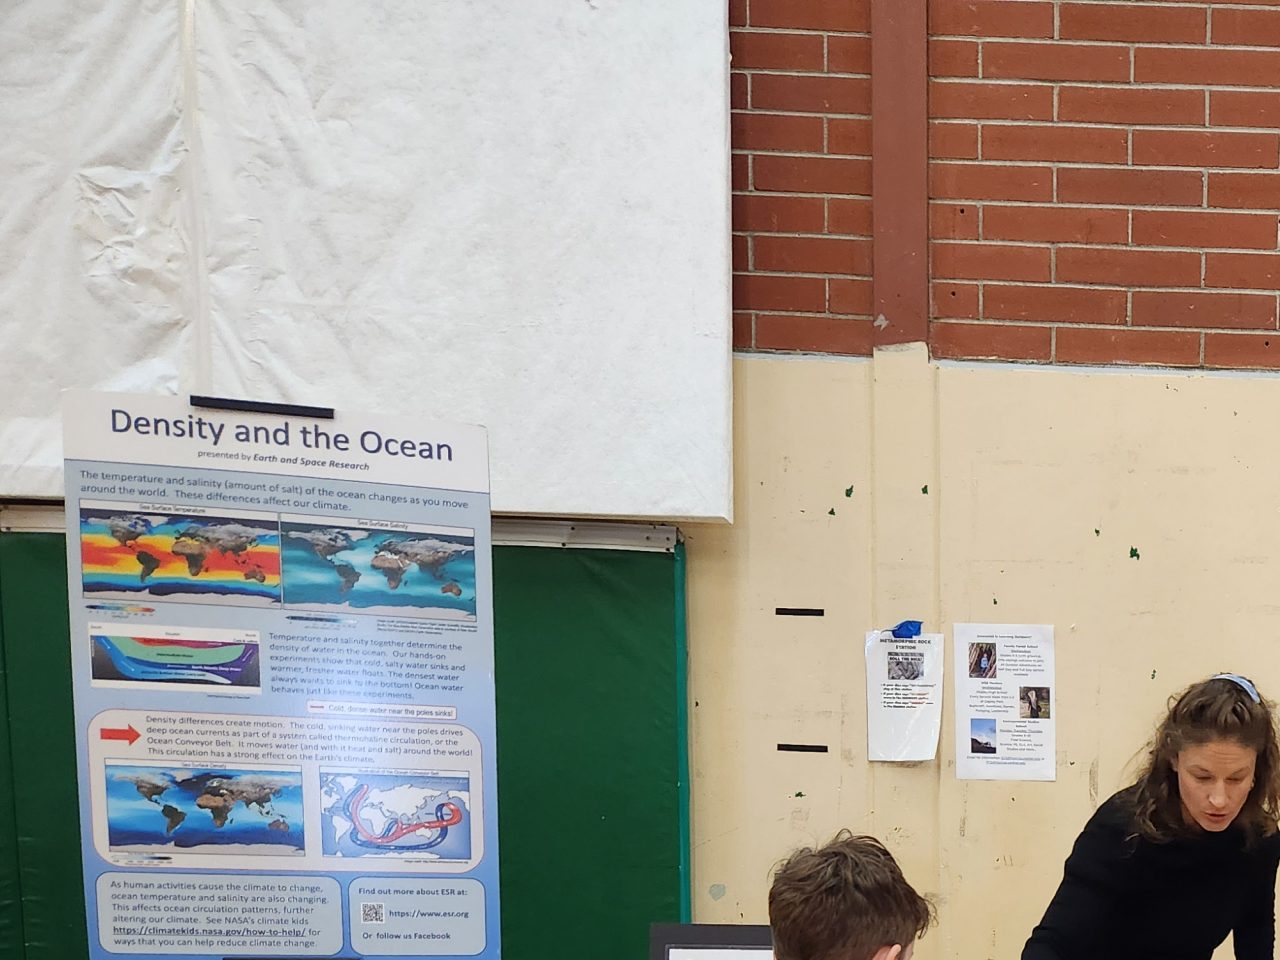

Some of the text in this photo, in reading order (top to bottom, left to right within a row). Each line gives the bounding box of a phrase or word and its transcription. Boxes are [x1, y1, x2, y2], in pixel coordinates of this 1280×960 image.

[112, 407, 452, 460] Density and the Ocean
[198, 451, 370, 470] presented by Earth and Space Research
[80, 468, 99, 479] The
[101, 470, 164, 484] temperature
[166, 476, 185, 485] and
[187, 477, 222, 491] salinity
[224, 479, 267, 492] (amount
[269, 484, 280, 493] of
[281, 485, 303, 498] salt)
[305, 486, 316, 496] of
[318, 487, 334, 497] the
[336, 491, 366, 500] ocean
[368, 491, 408, 505] changes
[422, 498, 440, 508] you
[442, 500, 469, 508] move
[80, 484, 116, 494] around
[118, 485, 135, 495] the
[175, 489, 204, 500] These
[206, 491, 261, 504] differences
[263, 496, 291, 506] affect
[293, 500, 311, 508] our
[110, 880, 122, 888] As
[123, 880, 155, 889] human
[157, 881, 197, 889] activities
[226, 882, 241, 890] the
[243, 883, 276, 891] climate
[278, 883, 287, 891] to
[359, 886, 376, 894] Find
[416, 887, 439, 895] about
[441, 887, 455, 895] ESR
[140, 892, 196, 903] temperature
[198, 893, 215, 901] and
[217, 894, 249, 904] salinity
[268, 894, 286, 902] also
[112, 903, 130, 911] This
[132, 903, 162, 912] affects
[192, 904, 239, 913] circulation
[283, 906, 314, 914] further
[113, 914, 147, 925] altering
[206, 916, 222, 924] See
[225, 916, 255, 924] NASA's
[257, 916, 289, 925] climate
[292, 917, 309, 925] kids
[389, 909, 469, 920] https://www.esr.org
[308, 929, 321, 937] for
[362, 931, 373, 939] Or
[376, 931, 401, 939] follow
[414, 931, 451, 939] Facebook
[114, 939, 136, 947] ways
[138, 937, 156, 945] that
[158, 940, 175, 948] you
[195, 938, 215, 948] help
[217, 938, 247, 946] reduce
[249, 938, 281, 946] climate
